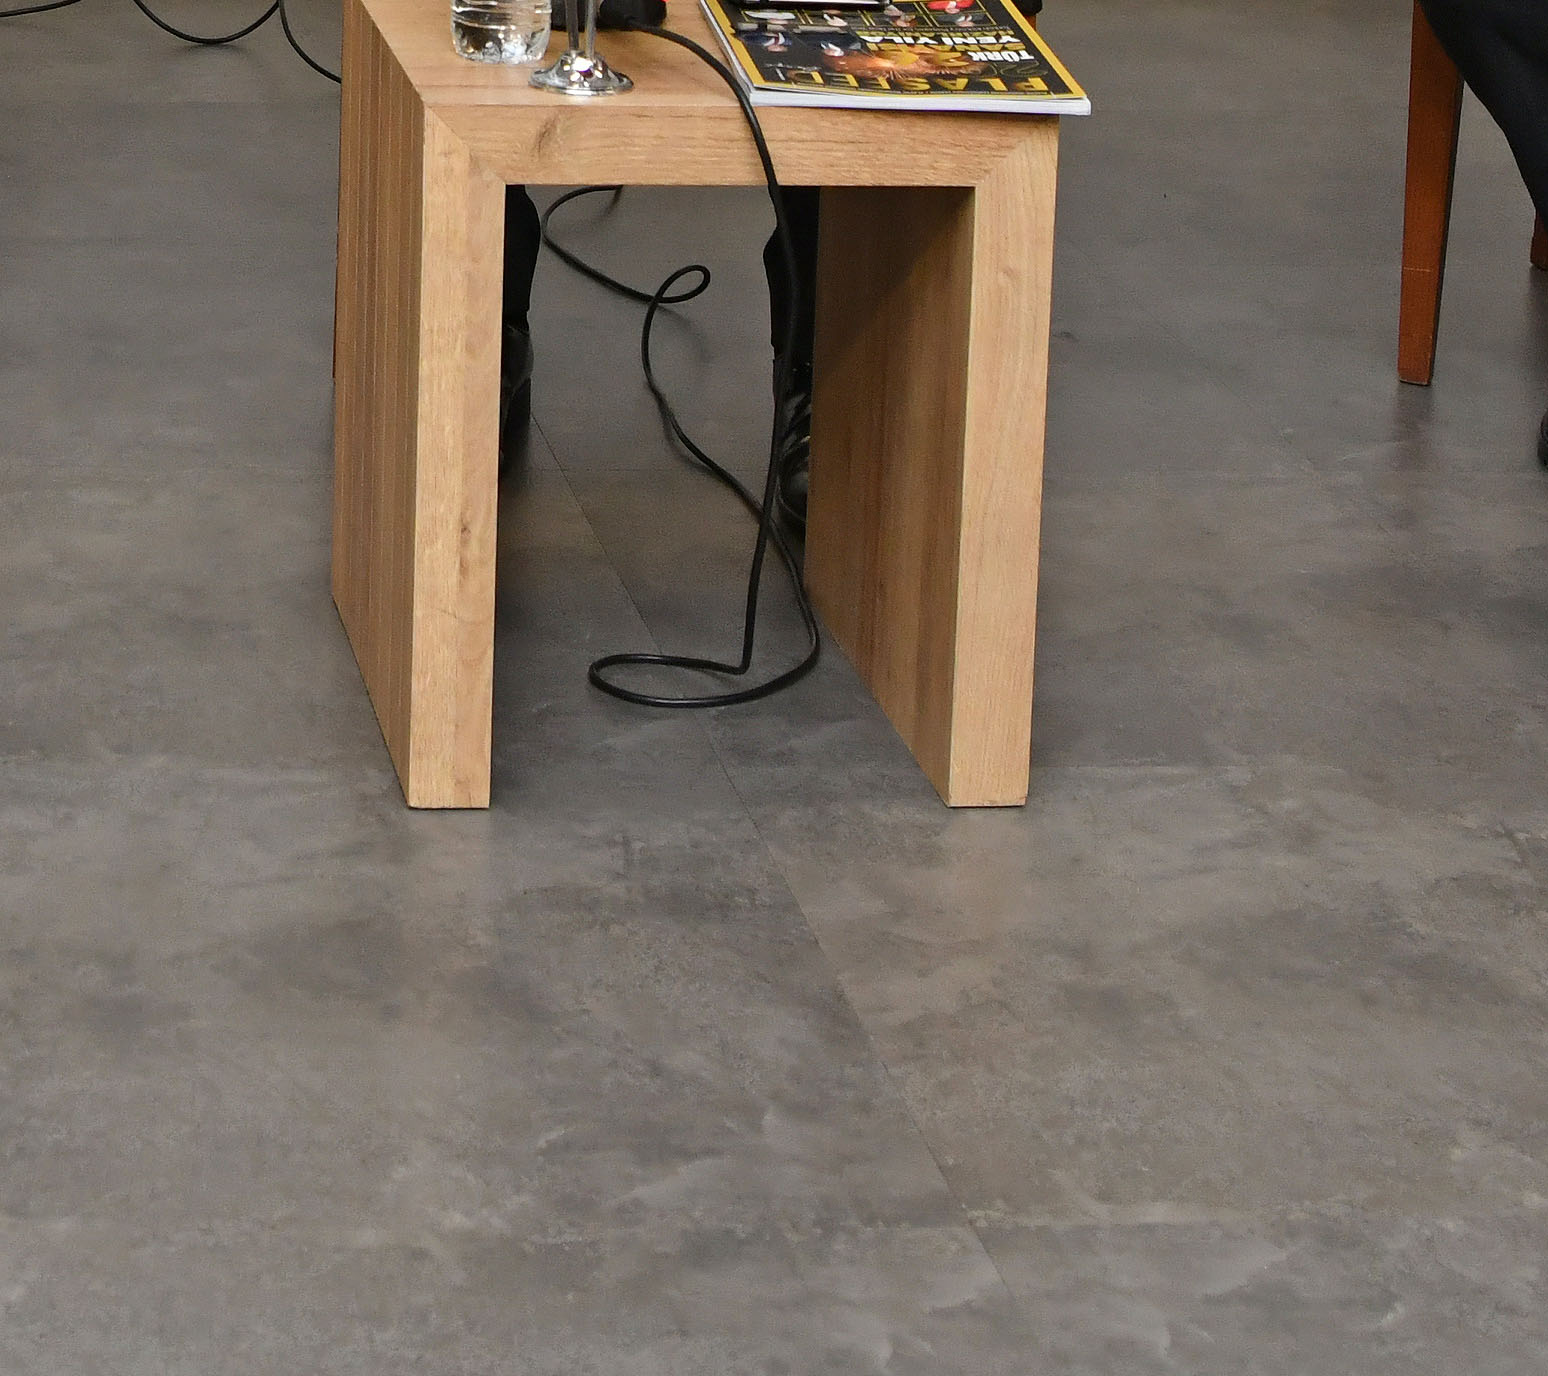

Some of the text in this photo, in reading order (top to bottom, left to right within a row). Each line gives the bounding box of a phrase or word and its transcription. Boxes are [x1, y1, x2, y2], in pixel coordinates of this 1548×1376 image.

[859, 34, 1021, 46] YENİ YILA
[967, 51, 1035, 62] TÜRK
[788, 70, 1049, 91] PLASFED
